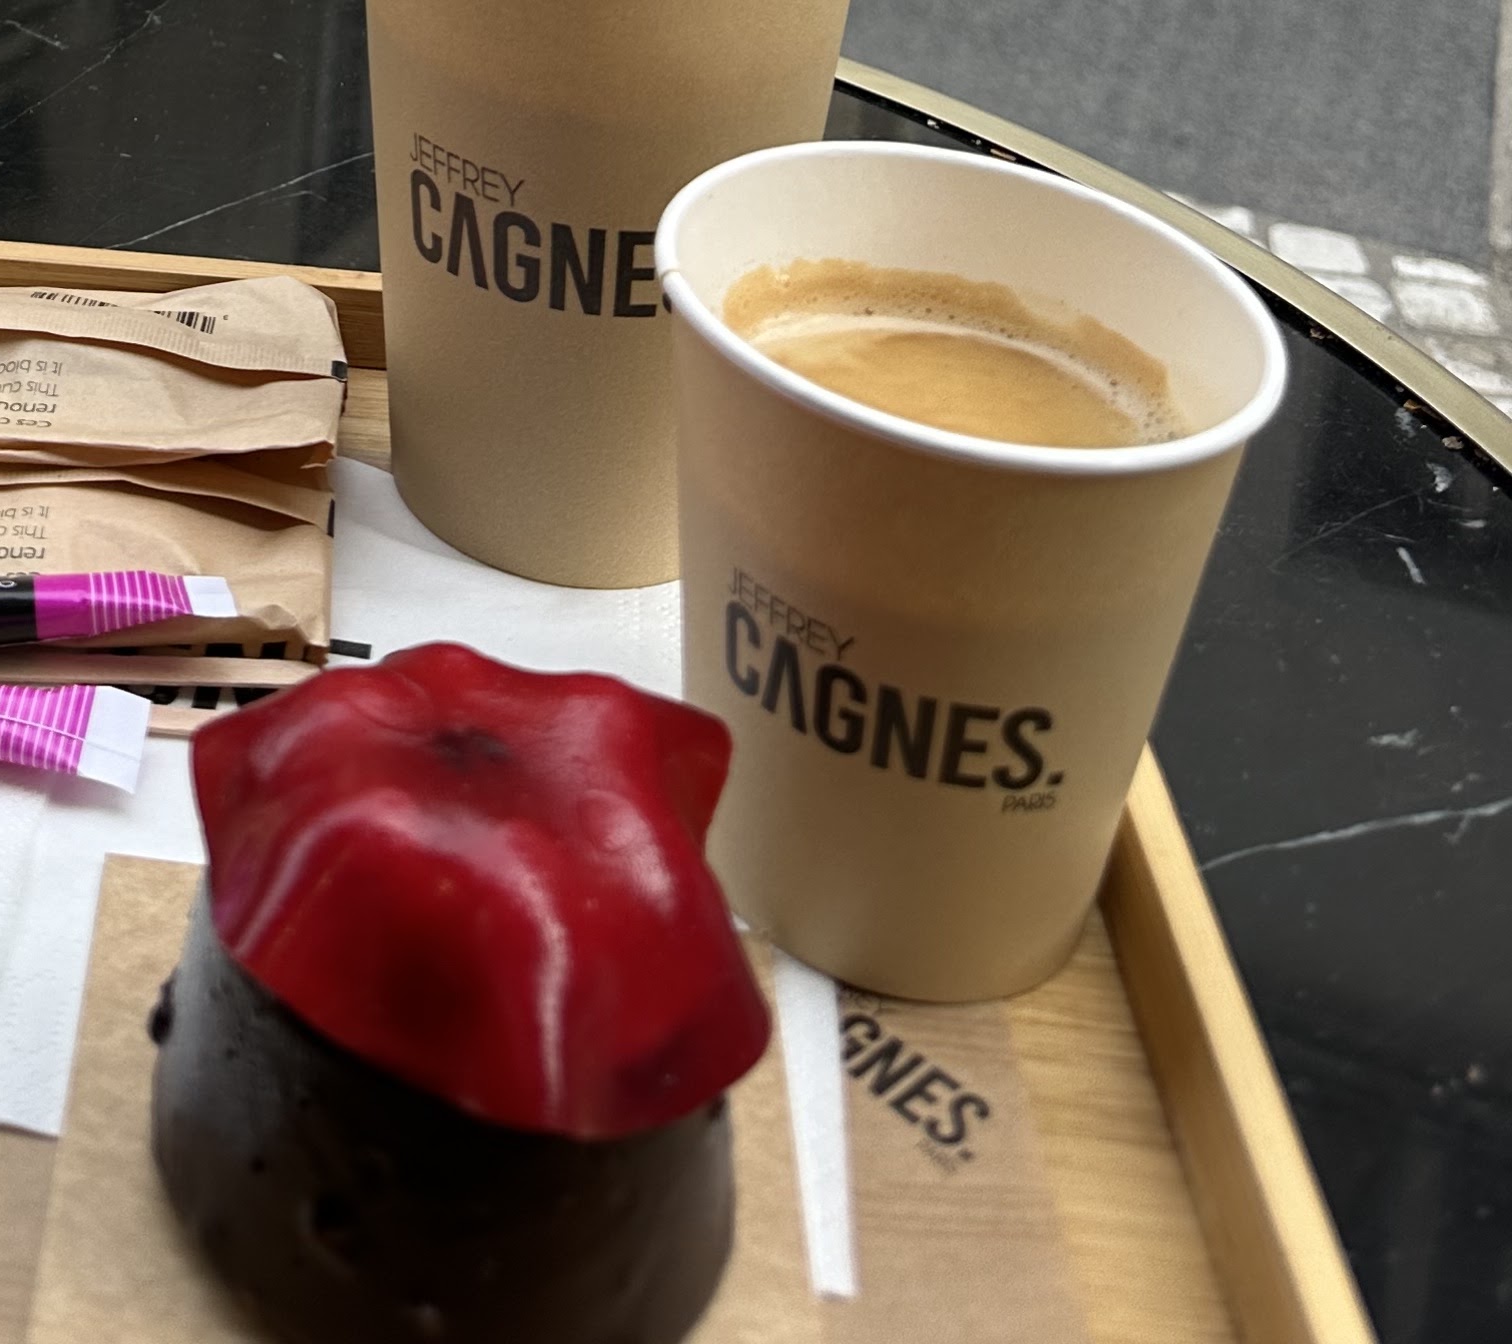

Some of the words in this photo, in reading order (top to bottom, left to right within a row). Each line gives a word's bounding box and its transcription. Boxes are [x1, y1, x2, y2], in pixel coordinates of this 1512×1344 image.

[409, 132, 525, 207] JEFFREY
[410, 168, 672, 318] CAGNE
[35, 360, 48, 374] is
[52, 361, 64, 376] It
[21, 380, 59, 397] This
[21, 505, 34, 517] is
[38, 505, 50, 519] It
[12, 525, 48, 540] This
[727, 566, 856, 662] JEFFREY
[1001, 790, 1057, 813] PARIS
